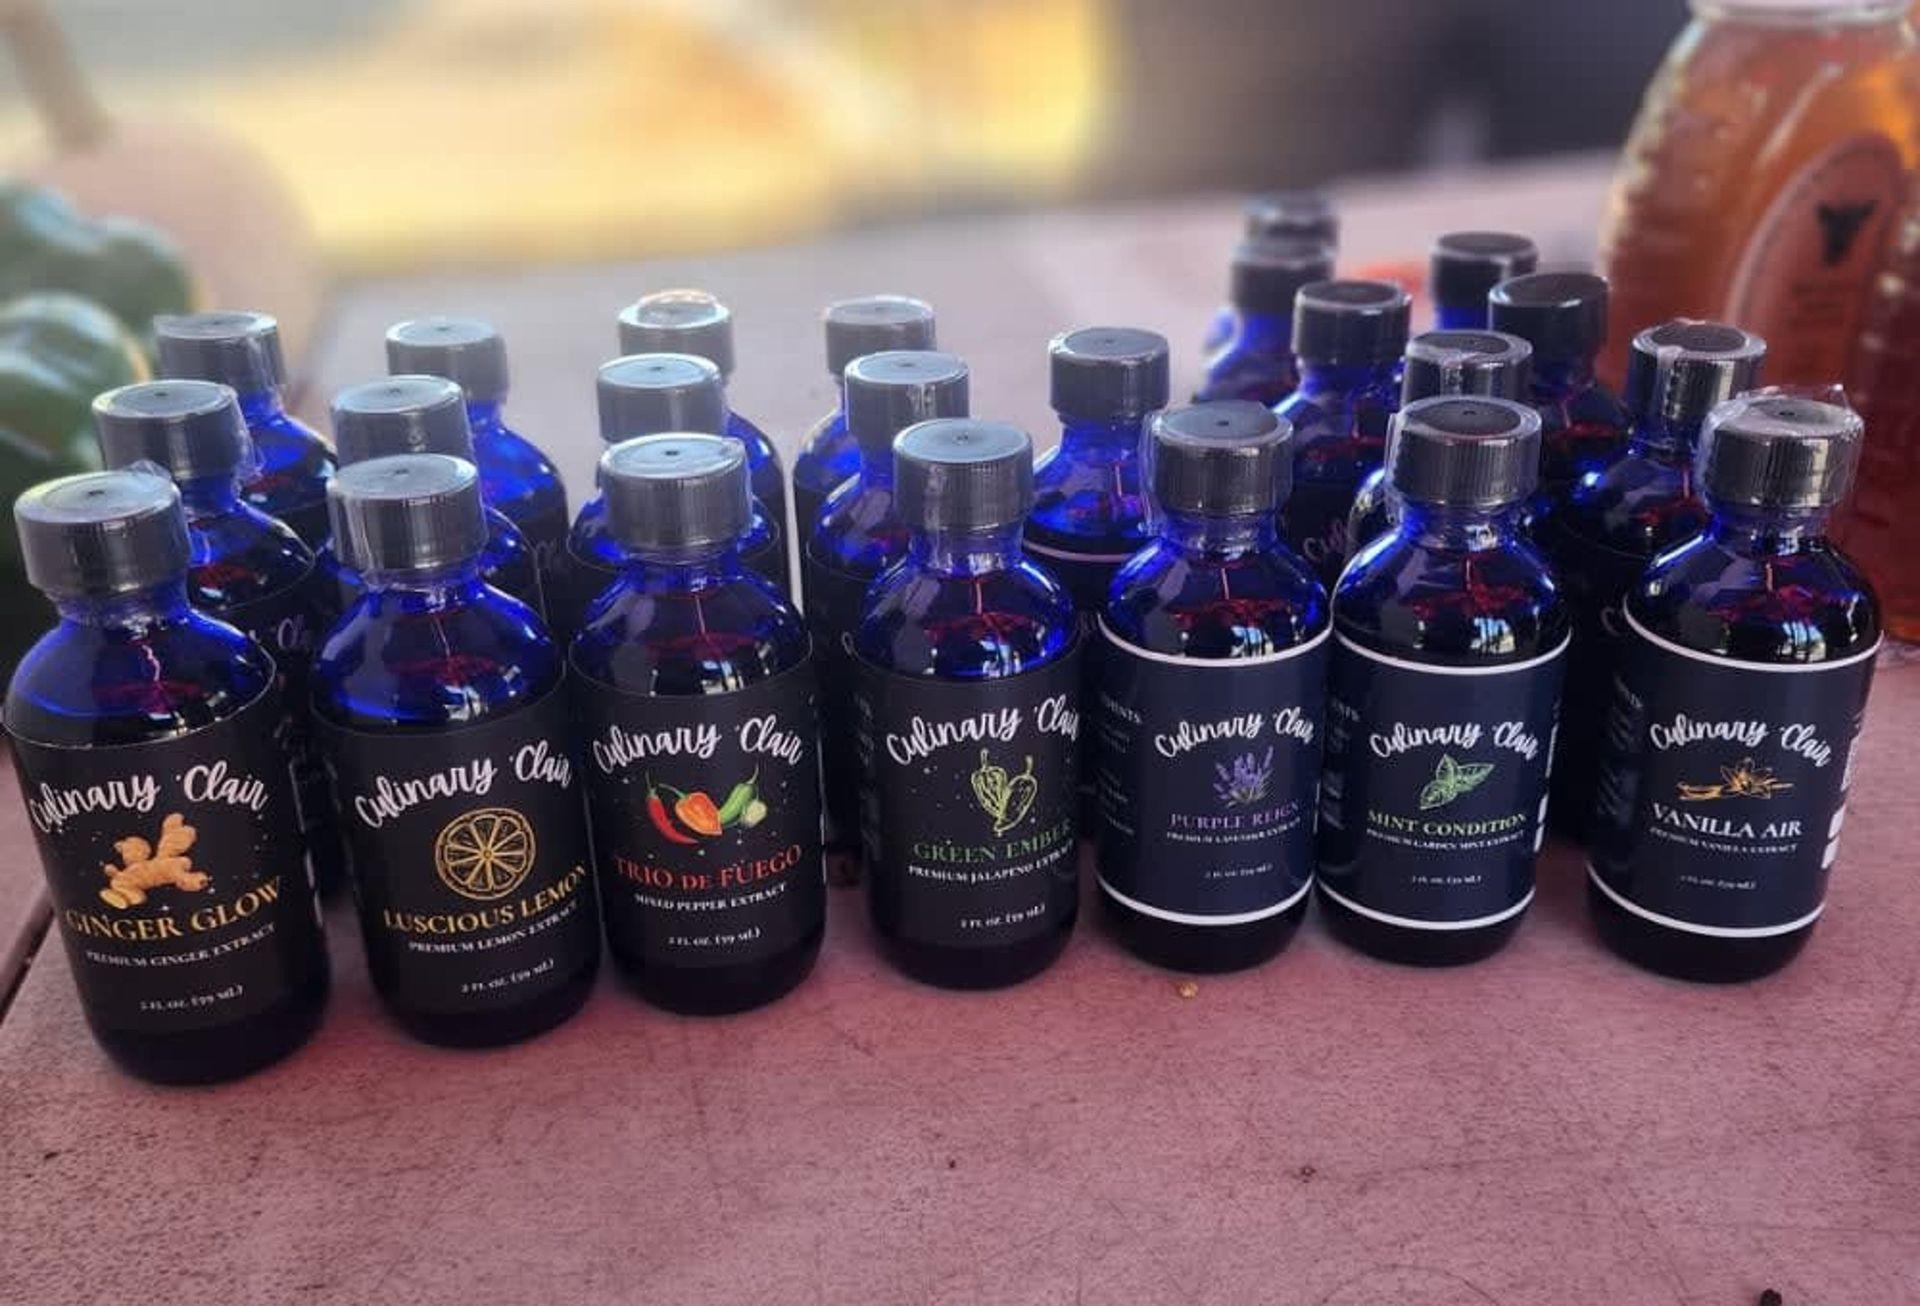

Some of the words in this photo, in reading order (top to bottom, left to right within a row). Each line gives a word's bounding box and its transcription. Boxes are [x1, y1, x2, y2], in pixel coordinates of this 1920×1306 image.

[593, 723, 722, 774] Culinary
[886, 708, 1022, 765] Culinary
[1154, 712, 1264, 758] Culinary
[1369, 722, 1483, 758] Culinary
[1650, 713, 1769, 750] Culinary
[29, 774, 161, 833] Culinary
[355, 757, 498, 828] Culinary
[1367, 810, 1419, 832] MINT
[1423, 813, 1527, 836] CONDITION
[1653, 802, 1755, 838] VANILLA
[1761, 819, 1802, 838] AIR
[913, 842, 996, 863] GREEN
[615, 857, 673, 888] TRIO
[682, 875, 711, 889] DE
[908, 865, 968, 882] PREMIUM
[65, 909, 184, 940] GINGER
[191, 875, 280, 931] GLOW
[383, 904, 514, 934] LUSCIOUS
[520, 865, 586, 917] LEMON
[677, 901, 726, 911] PEPPER
[731, 882, 786, 907] EXTRACT
[408, 941, 473, 953] PREMIUM
[478, 930, 526, 951] LEMON
